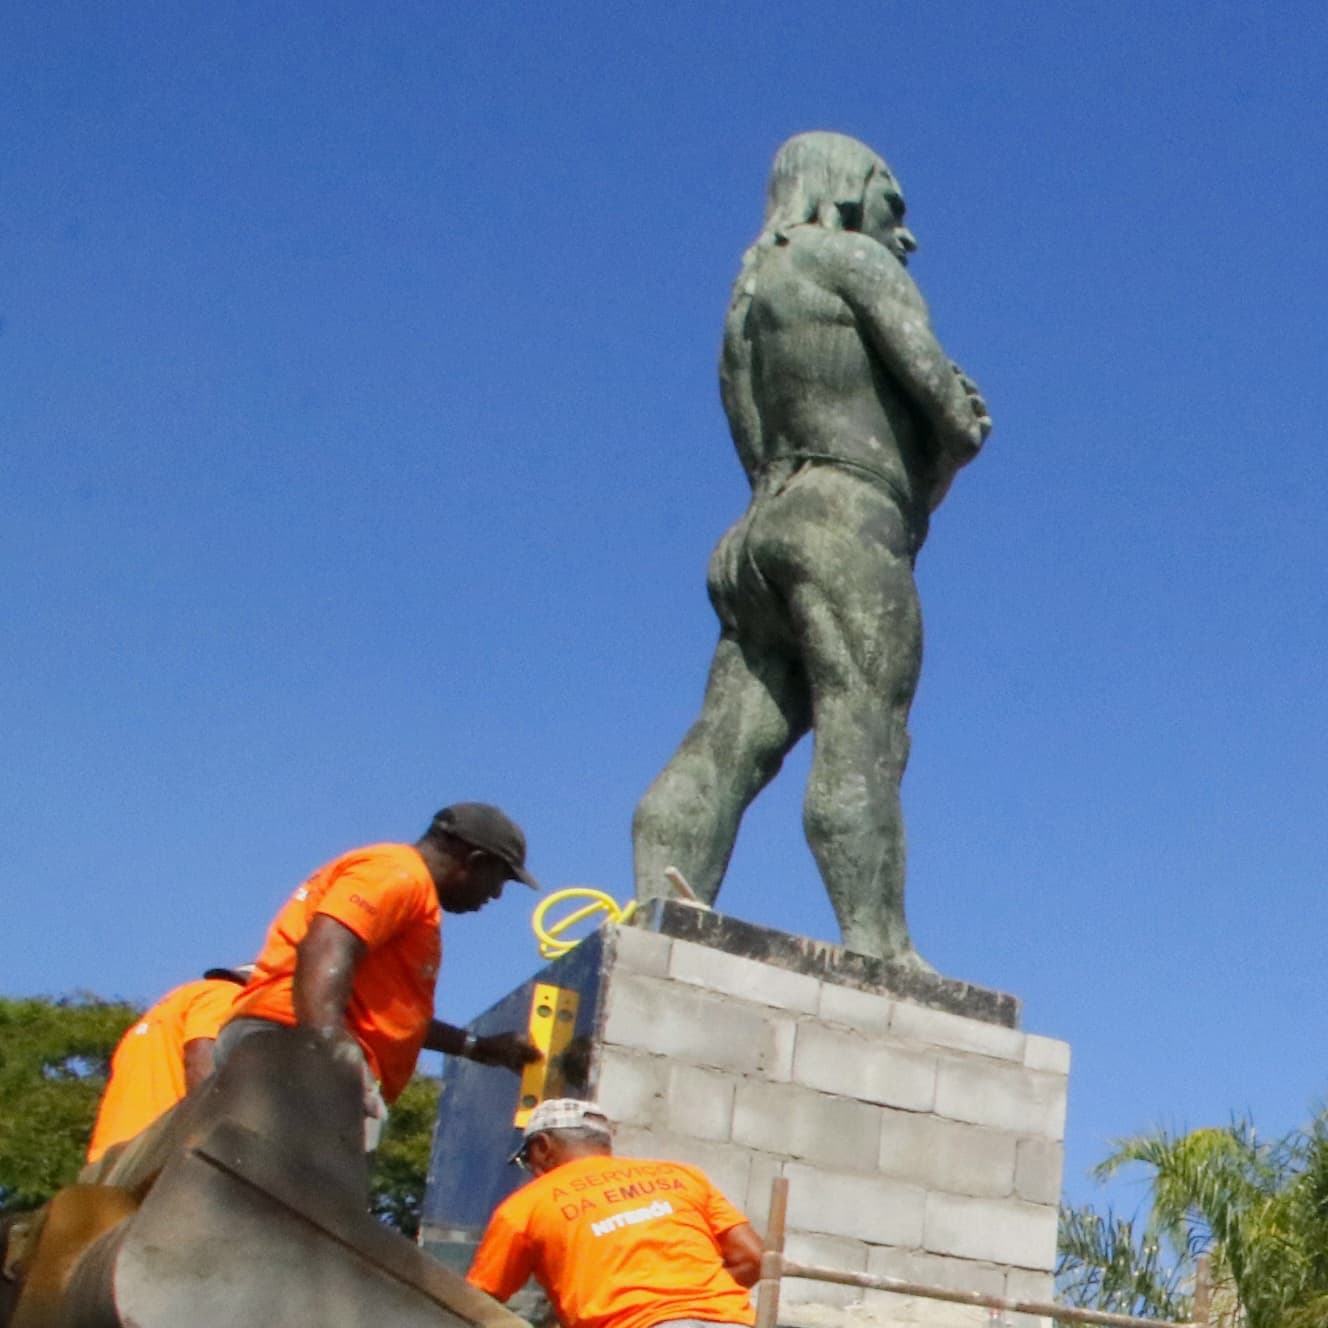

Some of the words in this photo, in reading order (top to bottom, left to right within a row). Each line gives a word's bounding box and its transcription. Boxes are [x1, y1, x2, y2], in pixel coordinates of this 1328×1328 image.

[551, 1186, 569, 1202] A
[560, 1197, 597, 1221] DA
[603, 1177, 687, 1204] EMUSA
